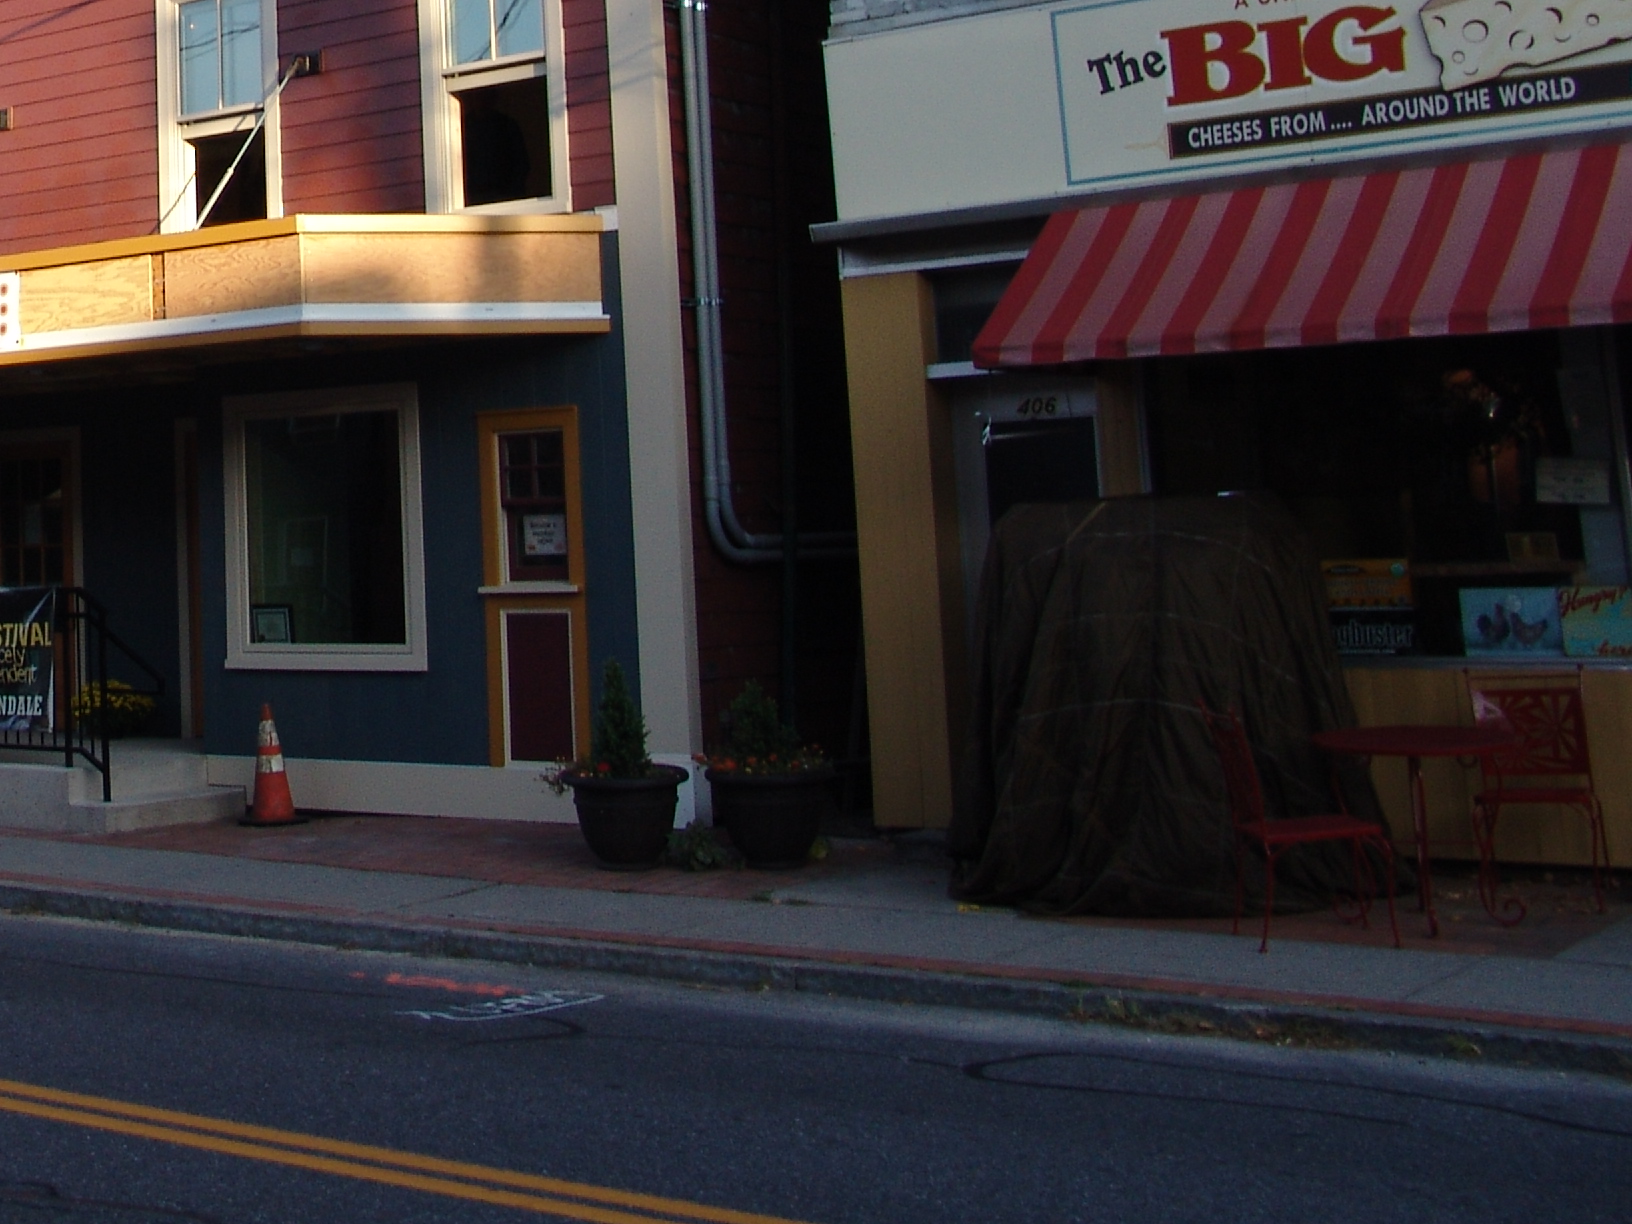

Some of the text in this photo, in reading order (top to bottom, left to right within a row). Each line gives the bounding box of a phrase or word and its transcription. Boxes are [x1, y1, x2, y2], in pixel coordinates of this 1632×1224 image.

[1087, 6, 1406, 107] The BIG
[1188, 119, 1263, 148] CHEESES
[1362, 94, 1449, 126] AROUND
[1453, 87, 1491, 114] THE
[1499, 76, 1576, 108] WORLD
[1017, 396, 1057, 414] 406
